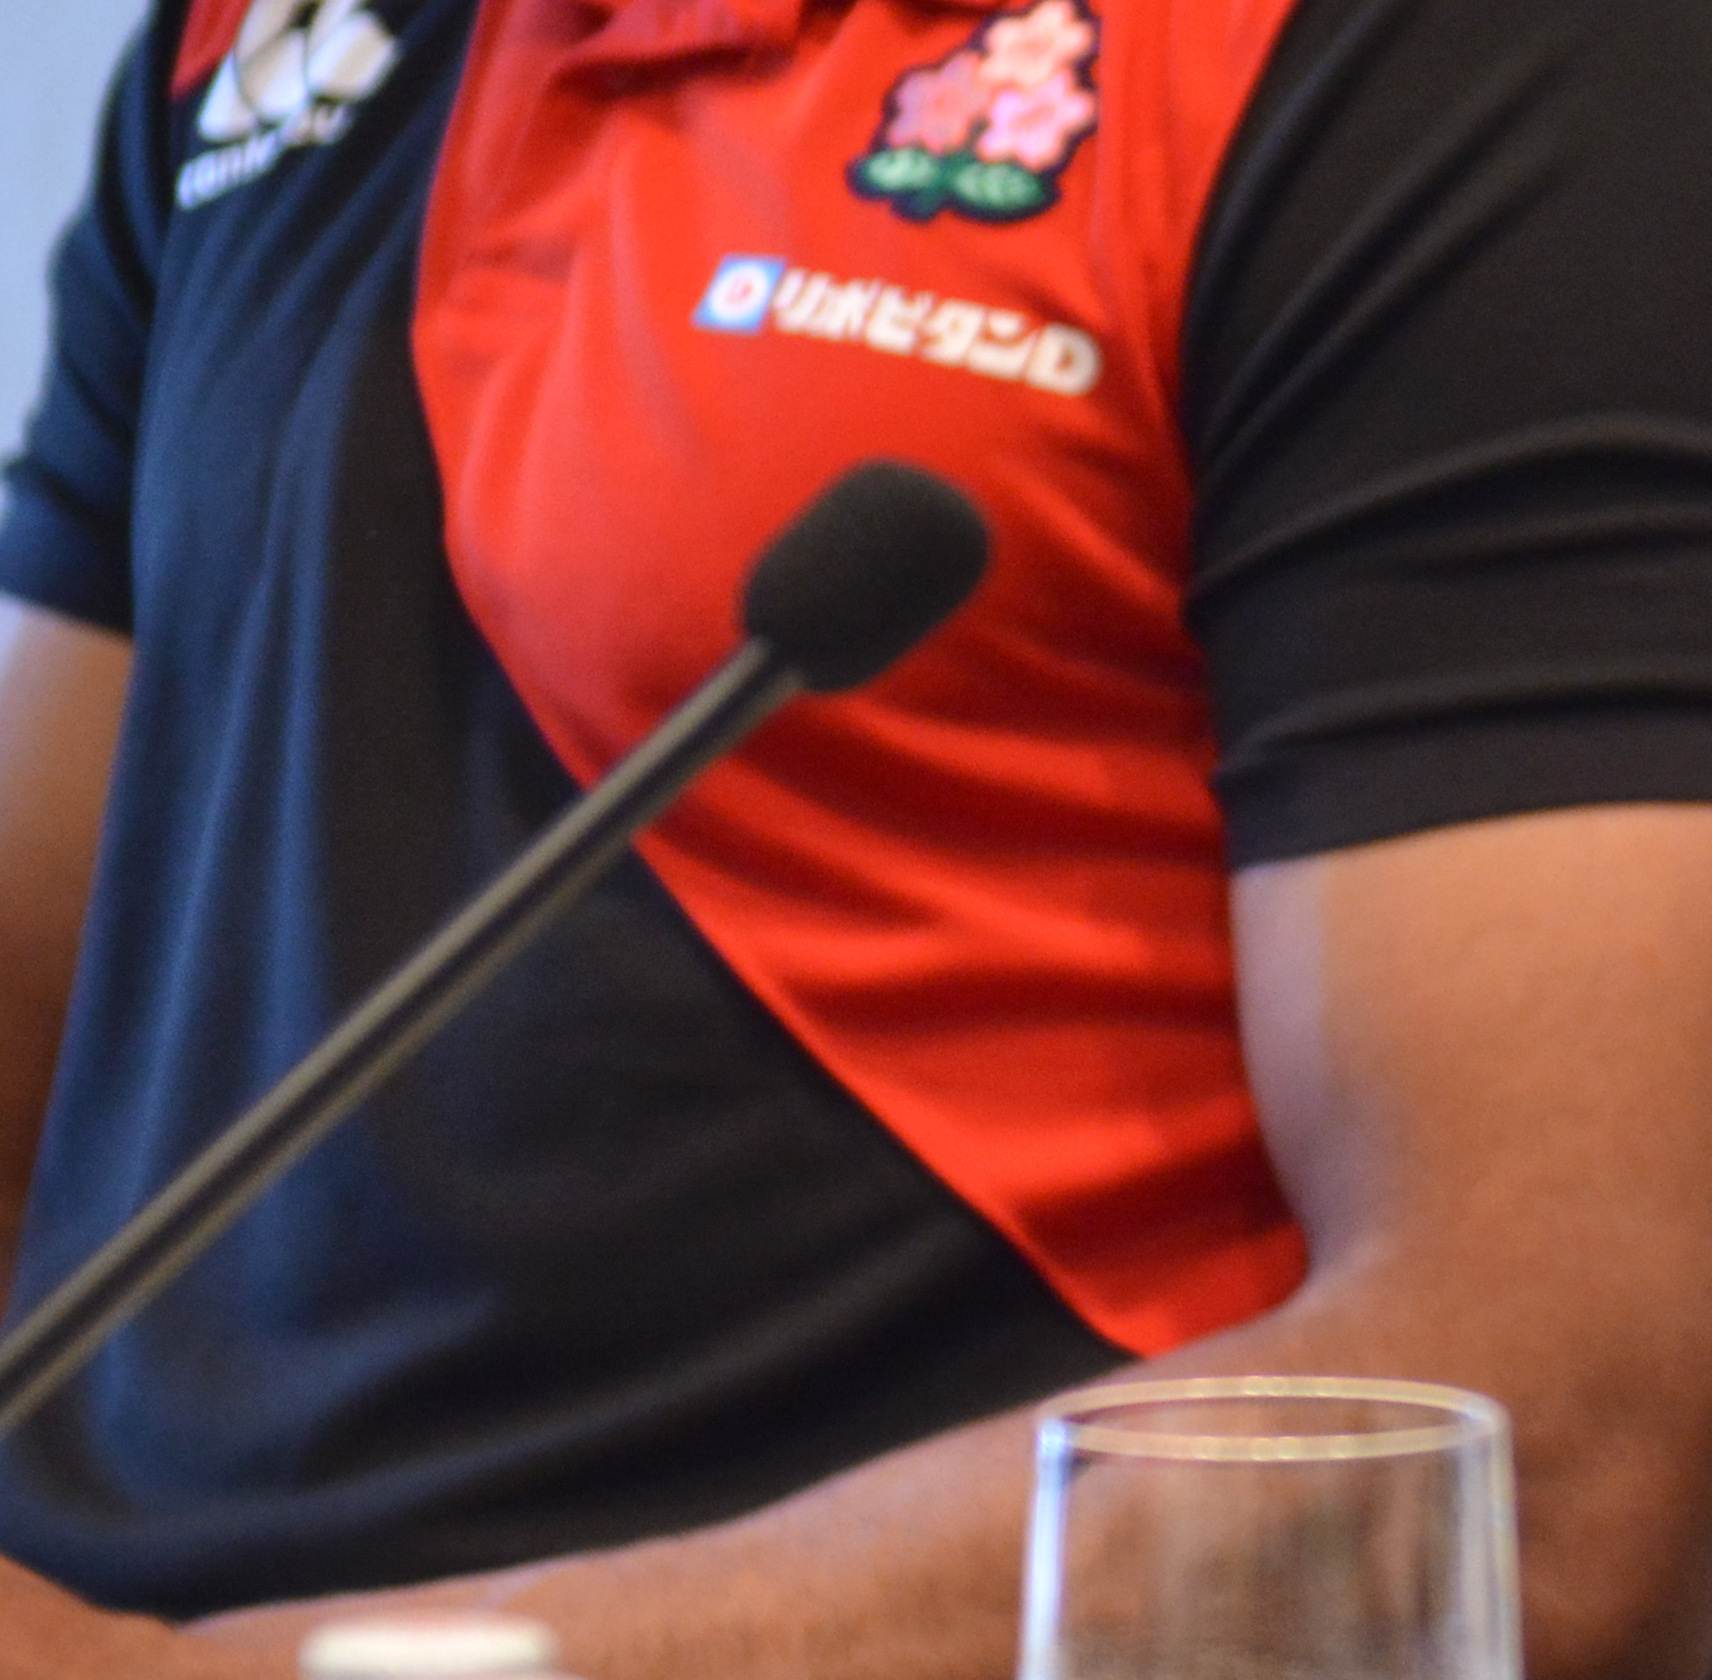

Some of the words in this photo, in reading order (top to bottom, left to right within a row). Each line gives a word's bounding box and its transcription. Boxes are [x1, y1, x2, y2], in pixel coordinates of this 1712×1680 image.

[771, 266, 1100, 396] リポビタンD
